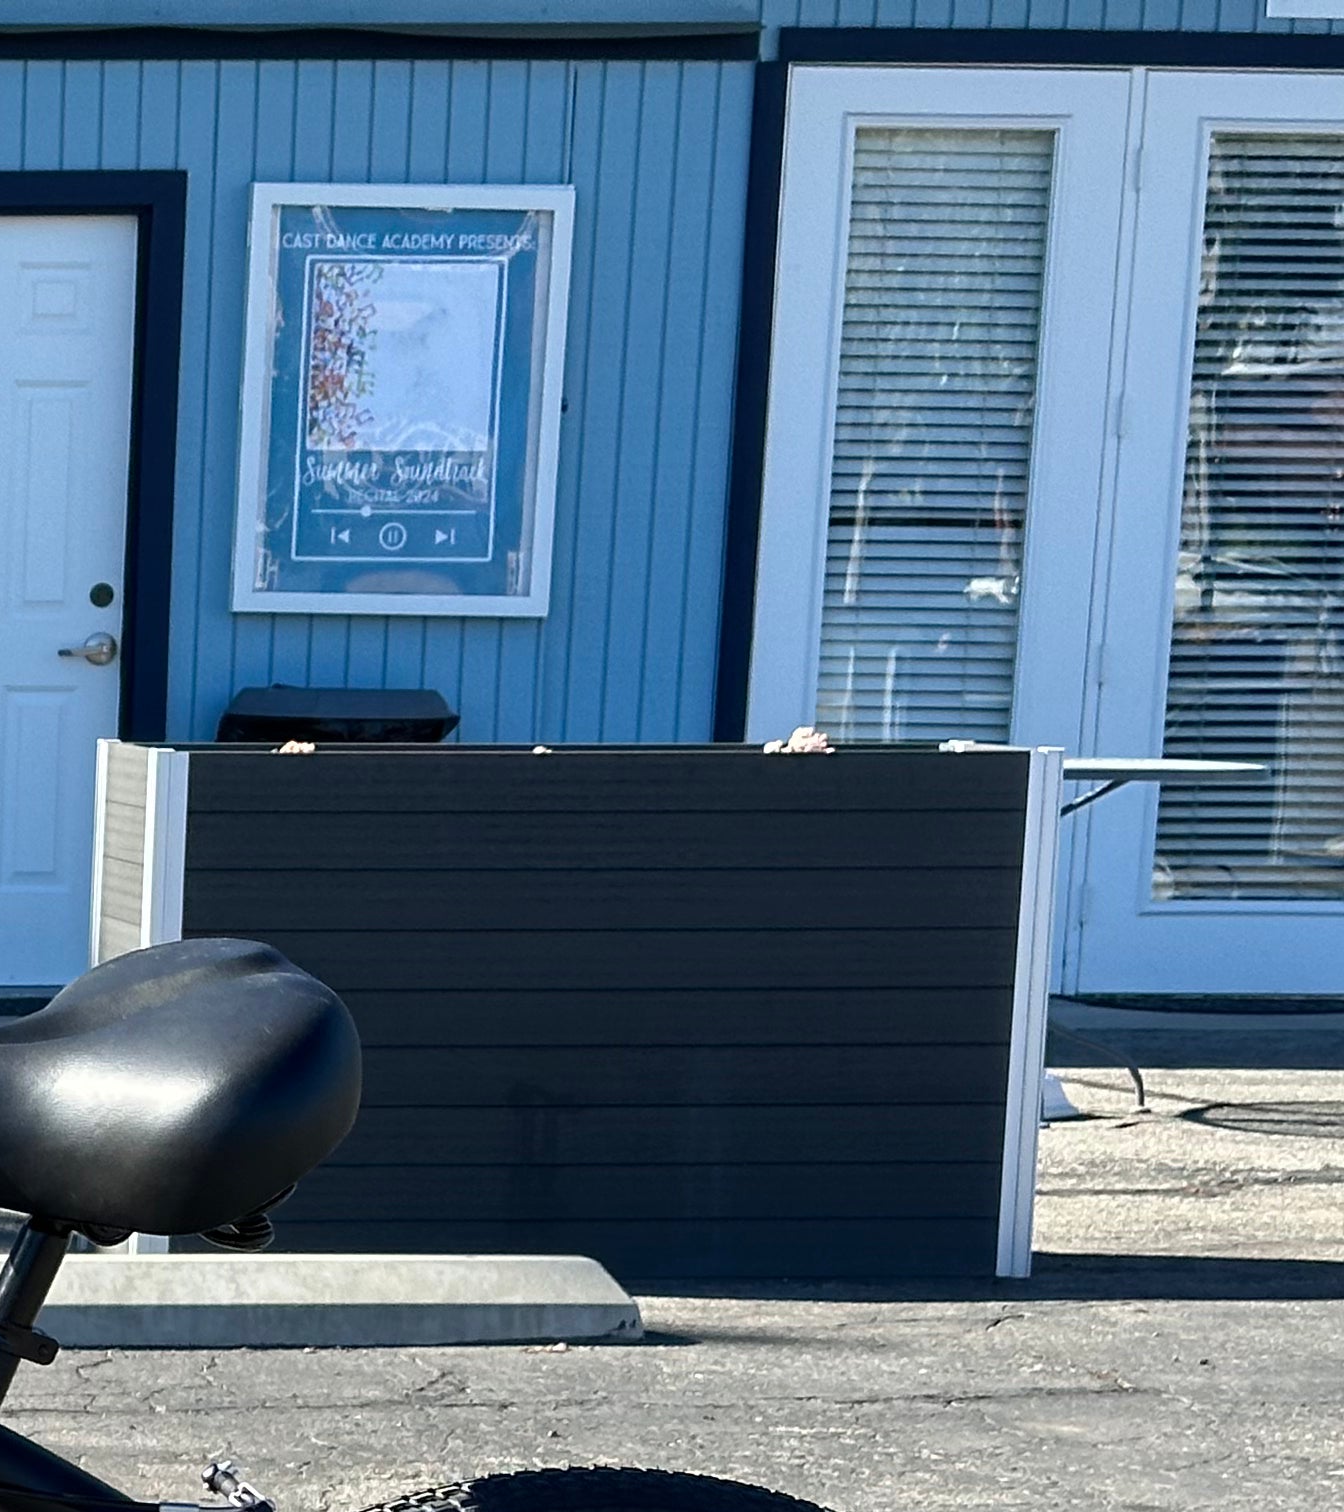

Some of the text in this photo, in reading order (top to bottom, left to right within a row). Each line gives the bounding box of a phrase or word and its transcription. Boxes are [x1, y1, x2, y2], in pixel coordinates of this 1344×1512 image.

[282, 232, 321, 249] CAST
[325, 233, 376, 250] DANCE
[382, 233, 453, 250] ACADEMY
